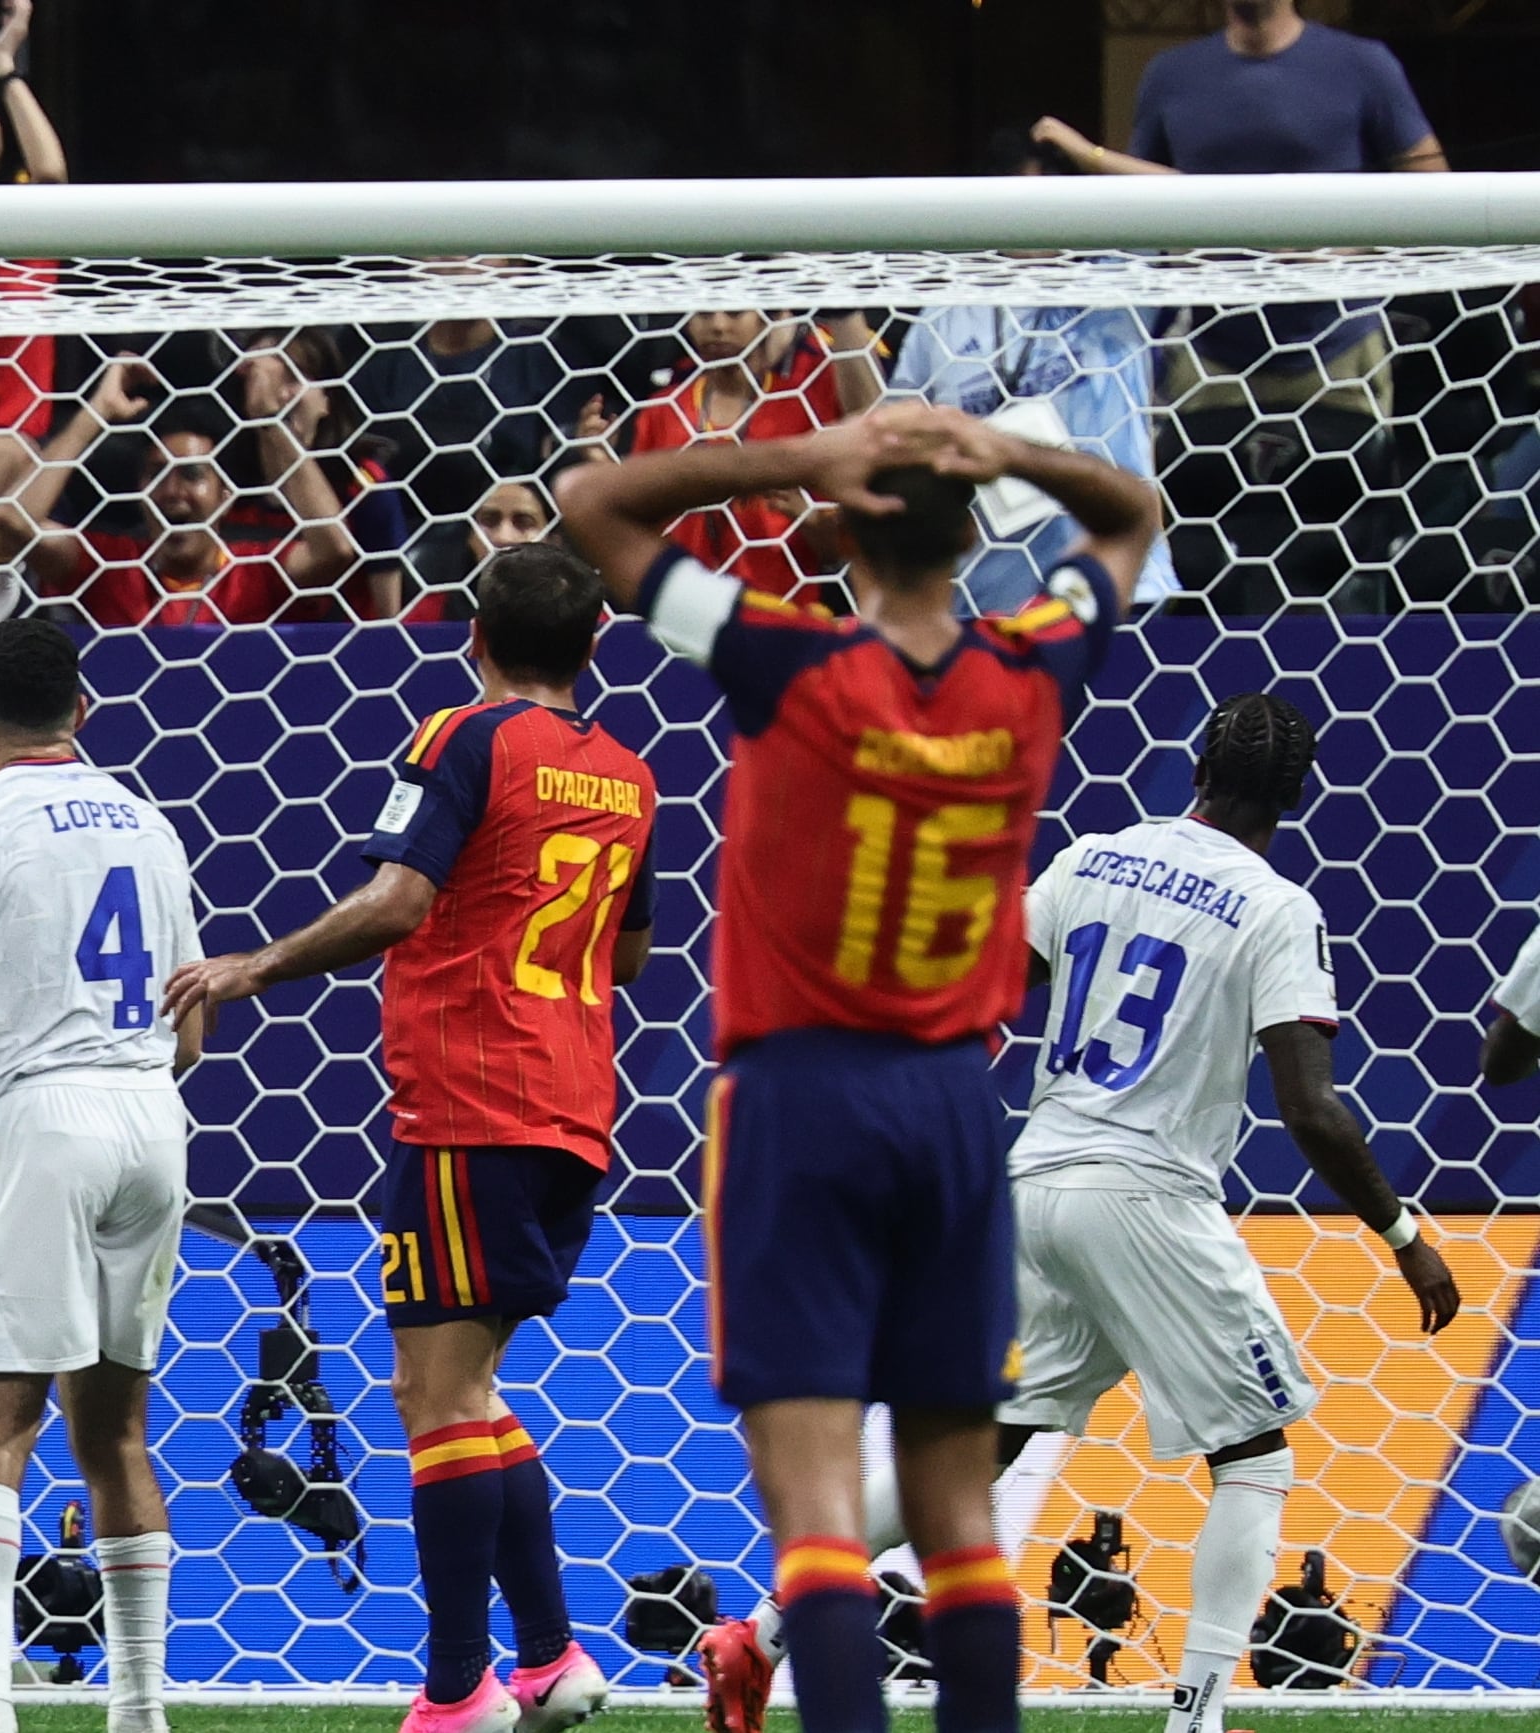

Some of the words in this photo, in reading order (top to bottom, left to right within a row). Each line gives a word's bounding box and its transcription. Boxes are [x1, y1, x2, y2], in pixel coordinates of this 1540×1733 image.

[44, 799, 140, 833] LOPES
[536, 765, 643, 819] OYARZABAL
[76, 866, 154, 1029] 4
[514, 833, 634, 1006] 21
[834, 794, 1008, 991] 16
[1046, 921, 1187, 1091] 13
[380, 1230, 427, 1303] 21
